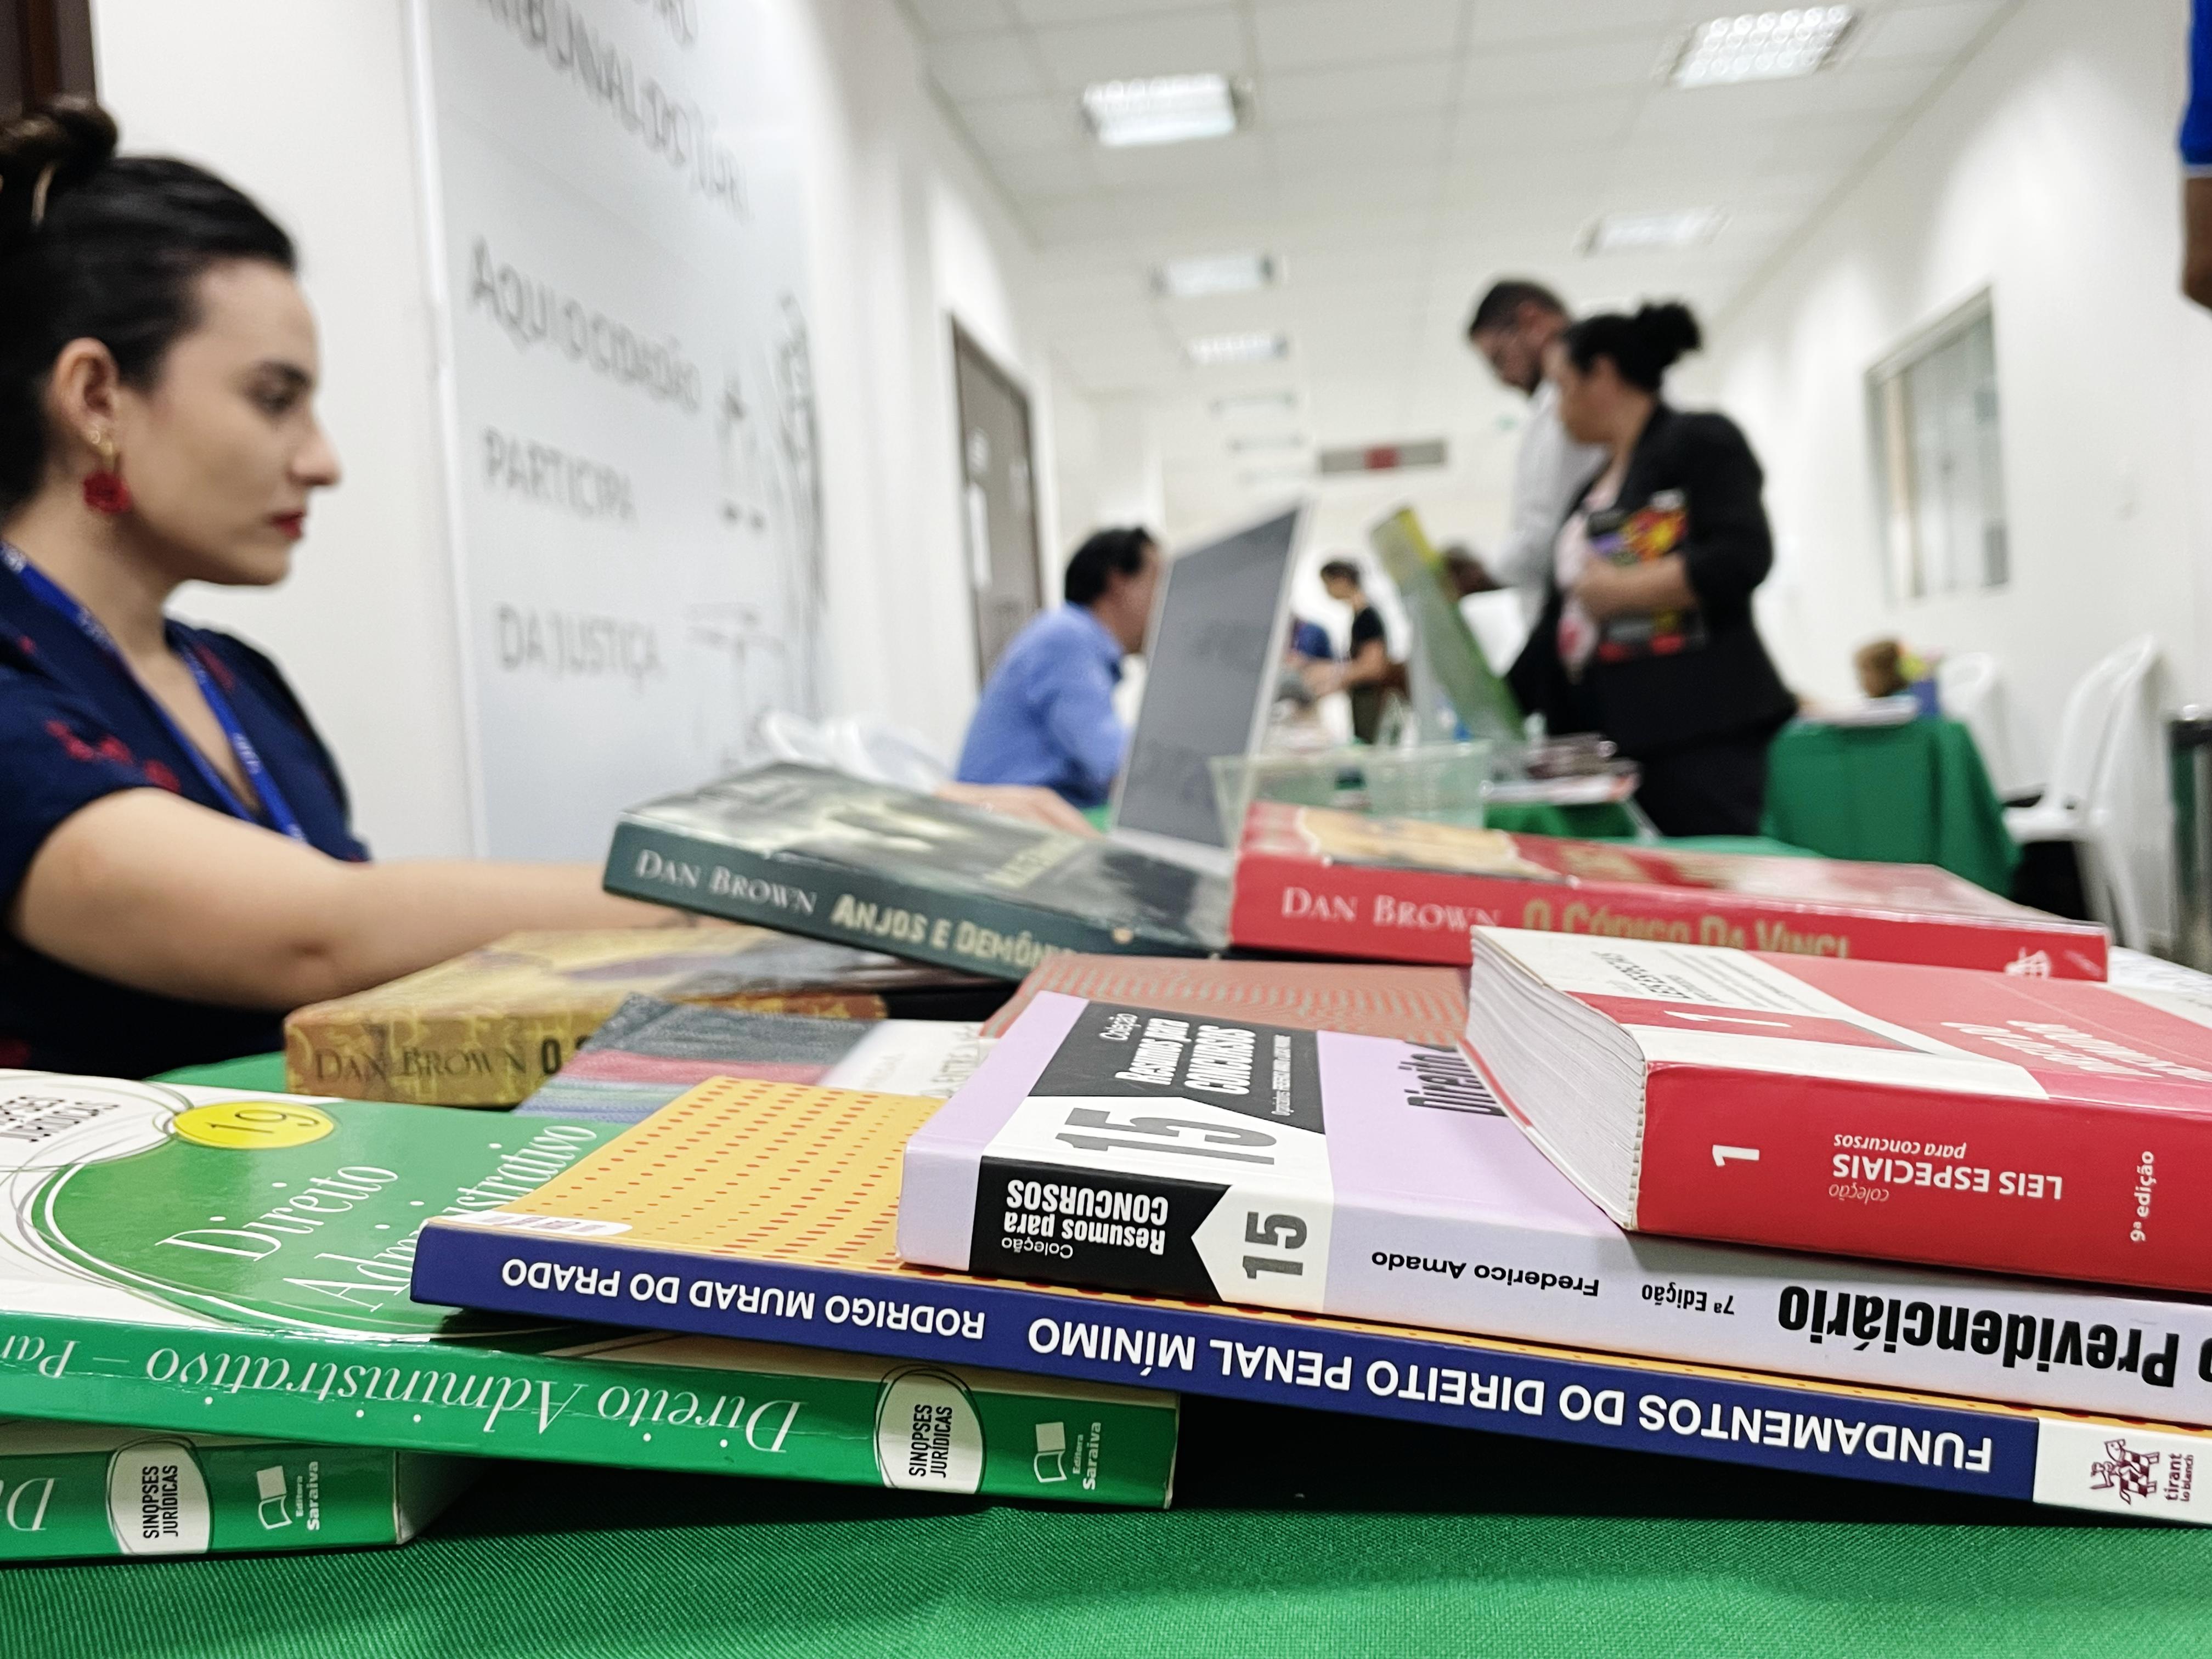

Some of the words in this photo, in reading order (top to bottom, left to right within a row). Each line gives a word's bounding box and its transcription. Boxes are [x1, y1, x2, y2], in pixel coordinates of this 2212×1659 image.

[495, 602, 546, 673] DA
[635, 849, 701, 889] DAN
[709, 865, 817, 916] BROWN
[830, 893, 928, 944] ANJOS
[930, 918, 953, 949] E
[1282, 887, 1358, 923] DAN
[1373, 894, 1502, 932] BROWN
[1143, 1017, 1192, 1043] para
[314, 1048, 386, 1081] DAN
[401, 1046, 527, 1077] BROWN
[1114, 1038, 1184, 1086] Resumos
[1183, 1024, 1256, 1095] CONCURSOS
[205, 1109, 321, 1135] 19
[1056, 1107, 1278, 1165] 15
[1833, 1133, 1921, 1155] concursos
[1711, 1144, 1760, 1167] 1
[1832, 1153, 1991, 1193] ESPECIAIS
[1924, 1142, 1967, 1159] para
[1006, 1179, 1169, 1226] CONCURSOS
[1828, 1183, 1889, 1204] coleção
[1999, 1171, 2063, 1200] LEIS
[2134, 1150, 2155, 1218] edição
[154, 1165, 399, 1262] Direito
[1003, 1211, 1056, 1238] para
[1001, 1236, 1074, 1259] Coleção
[1061, 1218, 1166, 1256] Resumos
[1242, 1211, 1308, 1280] 15
[501, 1259, 621, 1297] PRADO
[1371, 1251, 1466, 1279] Amado
[1474, 1265, 1600, 1297] Frederico
[629, 1273, 680, 1304] DO
[689, 1280, 816, 1320] MURAD
[1641, 1282, 1708, 1312] Edição
[824, 1295, 986, 1340] RODRIGO
[1778, 1285, 2180, 1388] Previdenciário
[1028, 1318, 1197, 1376] MÍNIMO
[1209, 1339, 1352, 1391] PENAL
[146, 1347, 589, 1435] Administrativo
[1365, 1360, 1545, 1416] DIREITO
[1559, 1384, 1626, 1426] DO
[597, 1385, 808, 1454] Direito
[908, 1403, 933, 1477] SINOPSES
[929, 1406, 953, 1479] JURÍDICAS
[1639, 1395, 1993, 1474] FUNDAMENTOS
[1073, 1434, 1084, 1475] Editora
[1082, 1421, 1102, 1491] Saraiva
[2163, 1453, 2182, 1501] tirant
[142, 1465, 160, 1539] SINOPSES
[158, 1465, 179, 1537] JURÍDICAS
[295, 1475, 304, 1518] Editora
[306, 1461, 320, 1531] Saraiva
